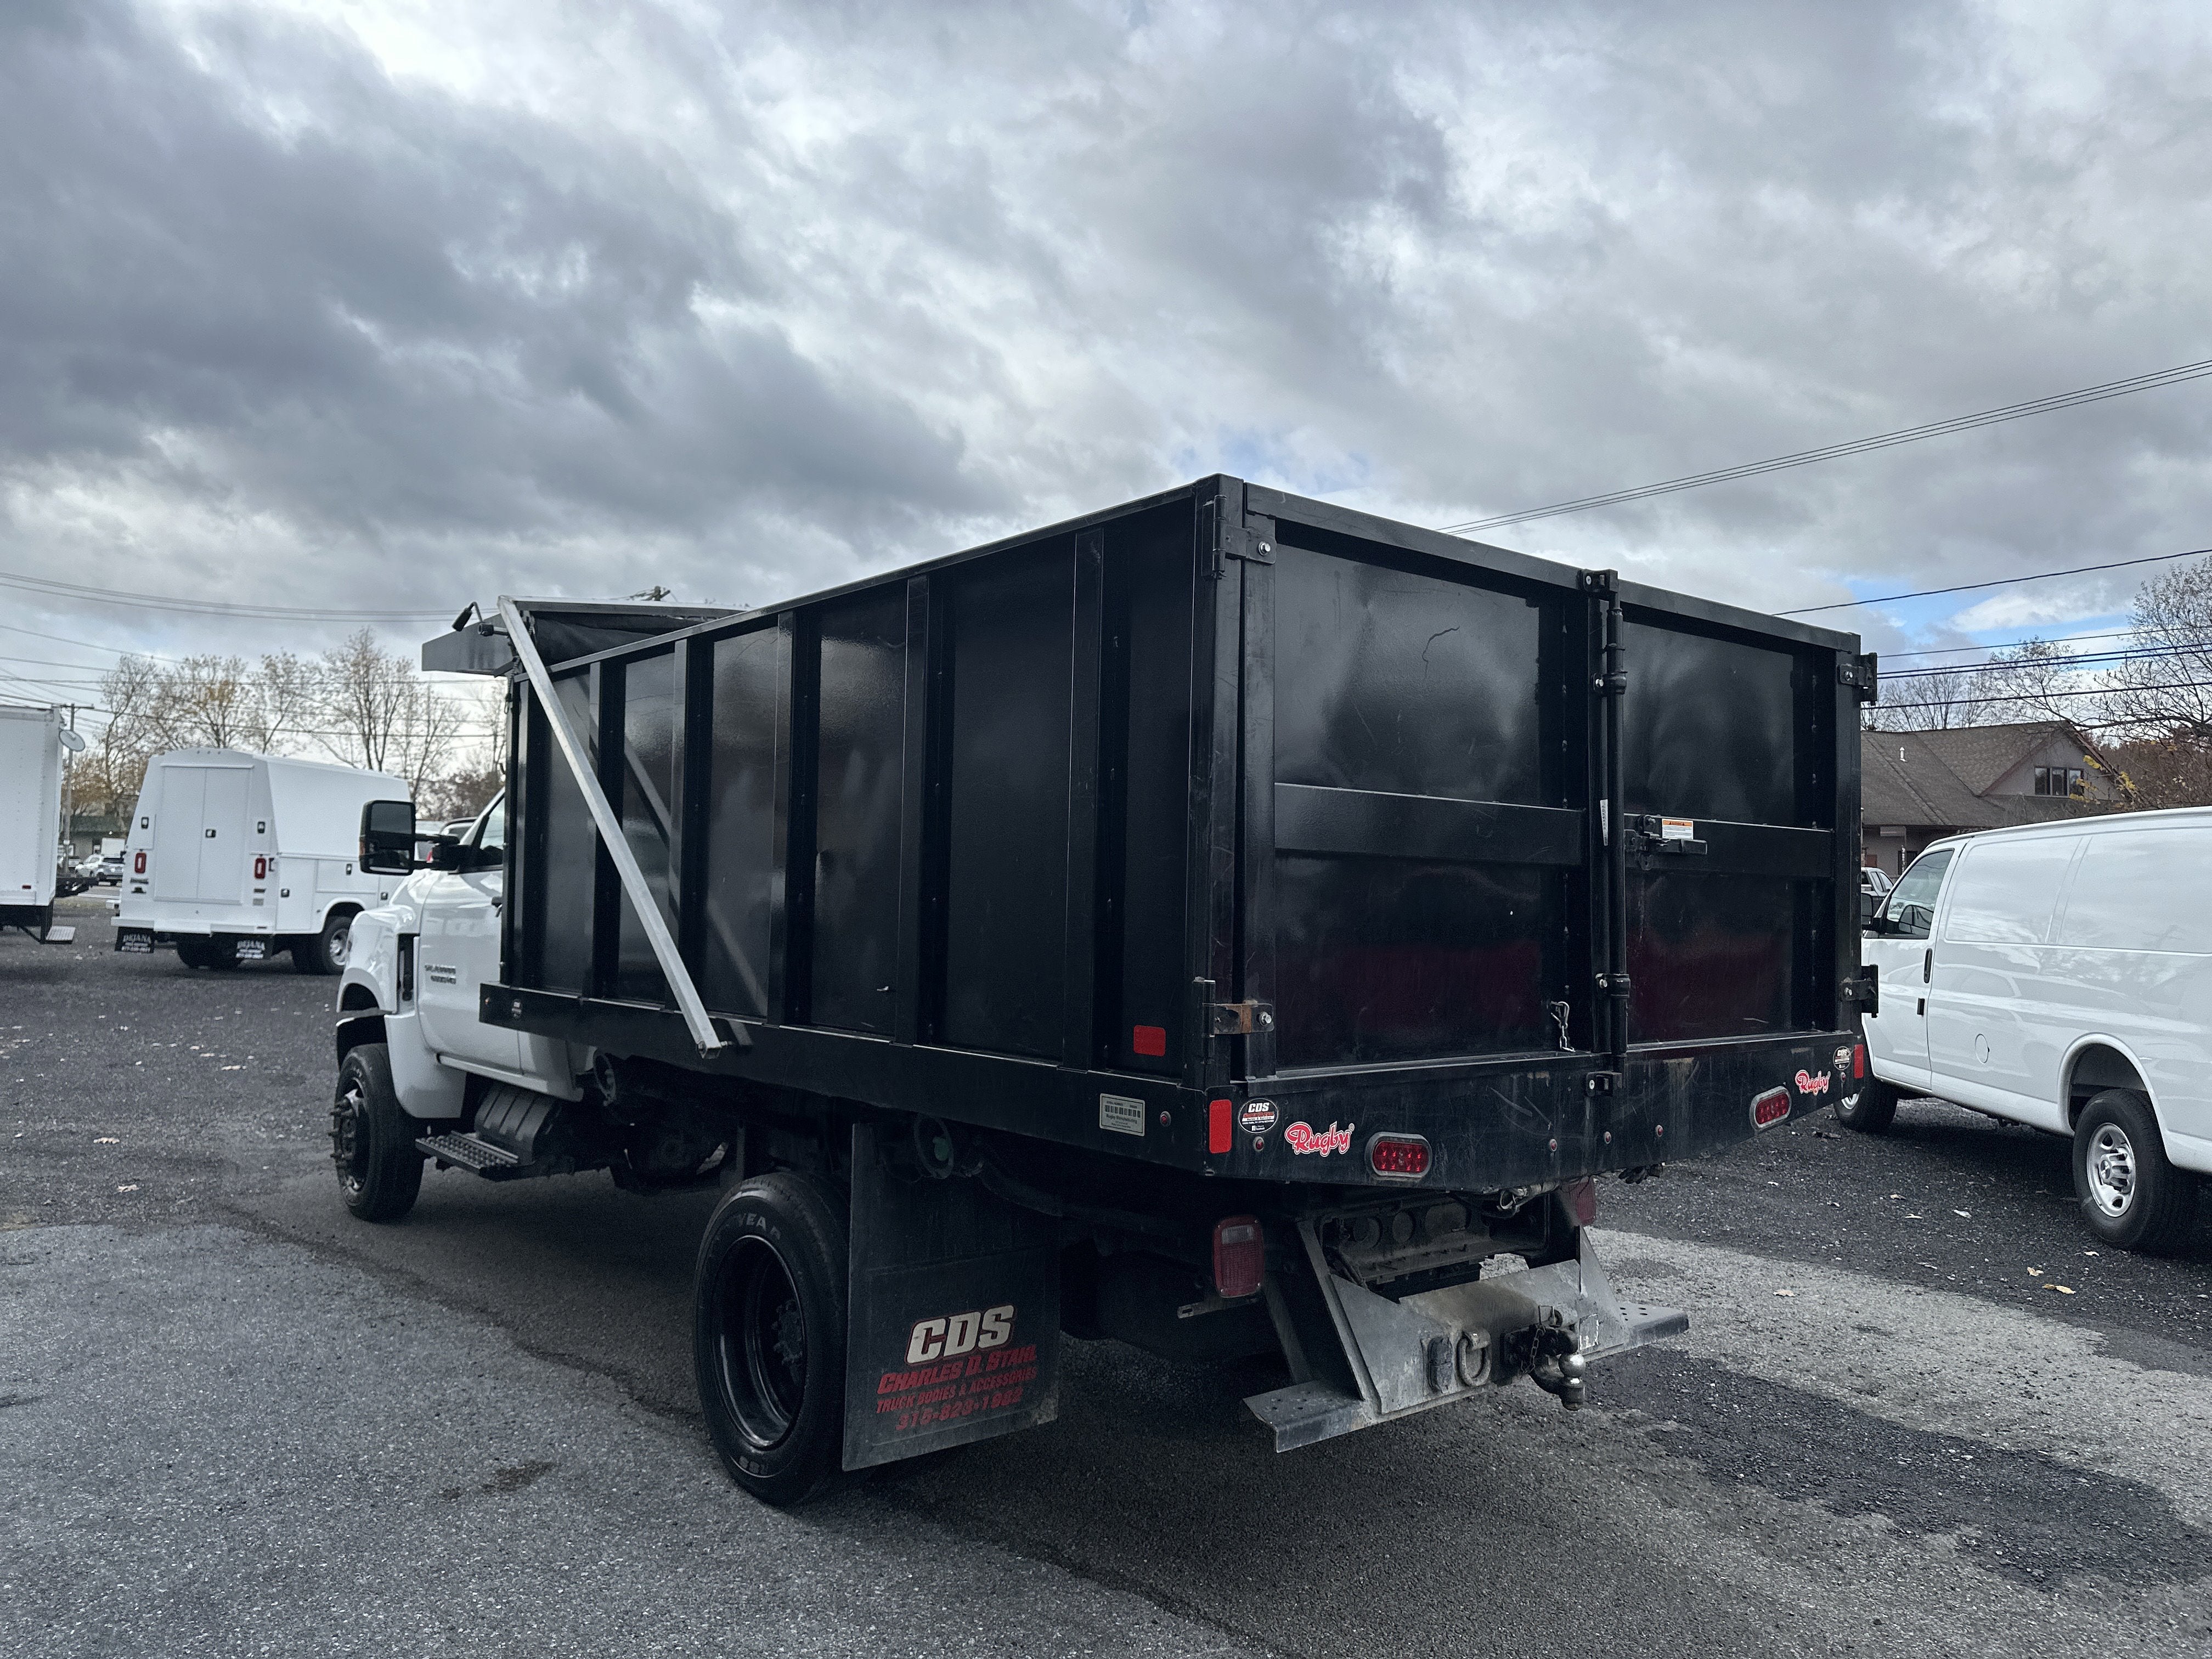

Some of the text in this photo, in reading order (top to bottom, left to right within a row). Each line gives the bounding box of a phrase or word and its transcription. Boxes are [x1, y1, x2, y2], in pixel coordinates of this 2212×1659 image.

[1795, 1070, 1829, 1096] Rugby
[1248, 1102, 1269, 1113] CDS
[1285, 1121, 1351, 1156] Rugby
[906, 1305, 1014, 1364] CDS
[876, 1367, 1037, 1414] TRUCK BODIES & ACCESSORIES
[877, 1361, 964, 1395] CHARLES
